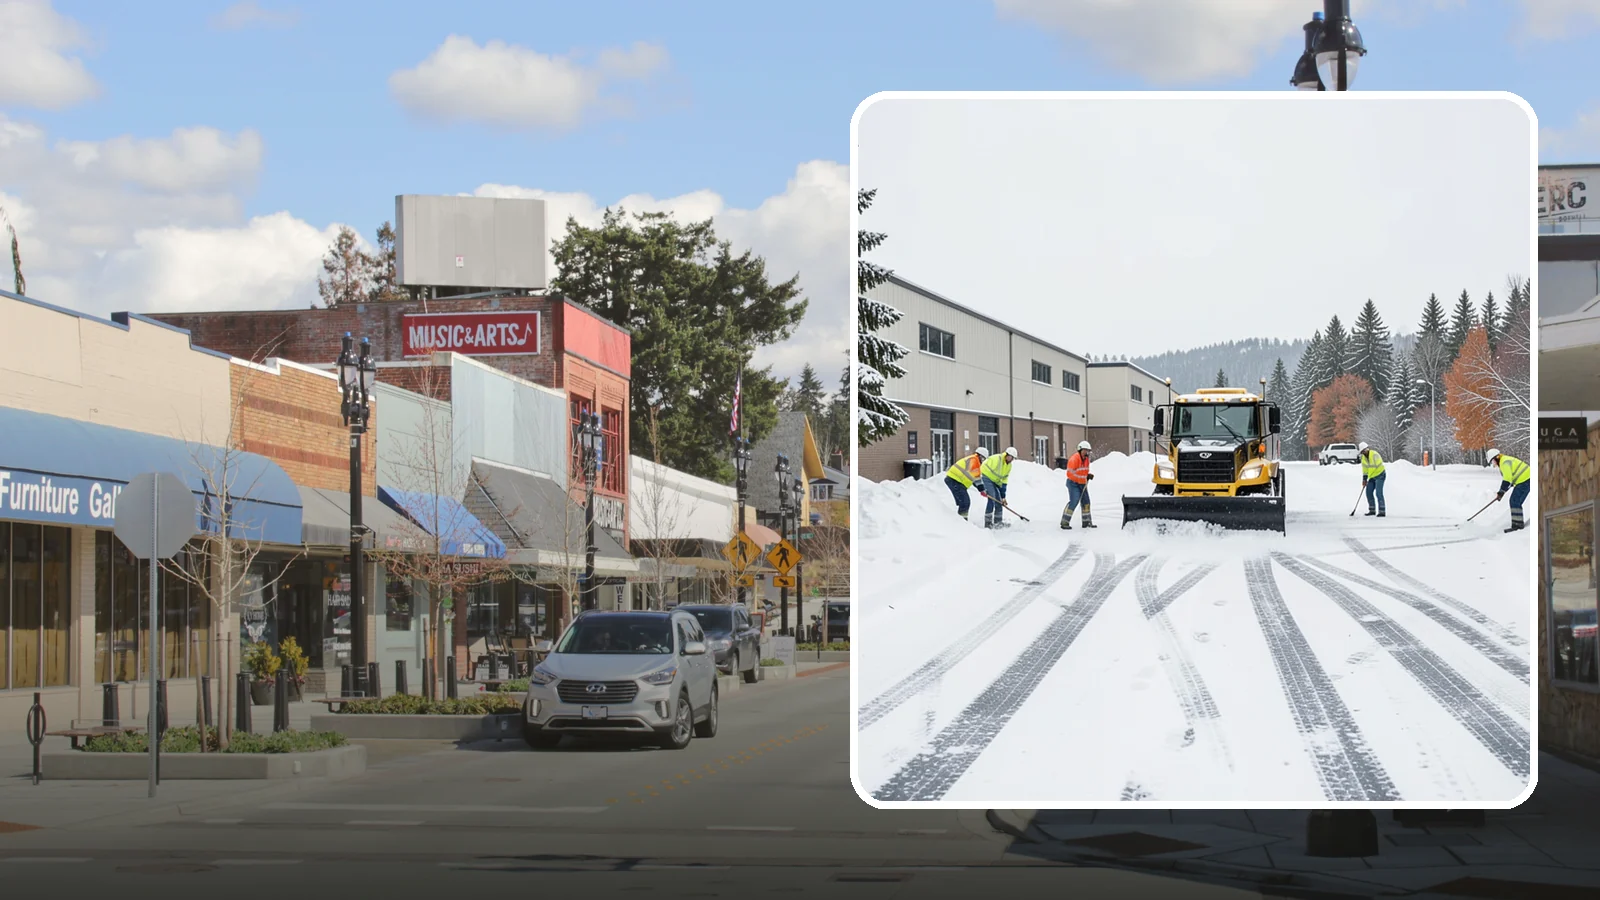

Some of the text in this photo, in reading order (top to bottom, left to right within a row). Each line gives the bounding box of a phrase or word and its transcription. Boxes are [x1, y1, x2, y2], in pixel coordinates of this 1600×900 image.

[409, 323, 520, 348] MUSIC&ARTS
[0, 471, 122, 519] Furniture Gal
[454, 563, 479, 574] SUSHI
